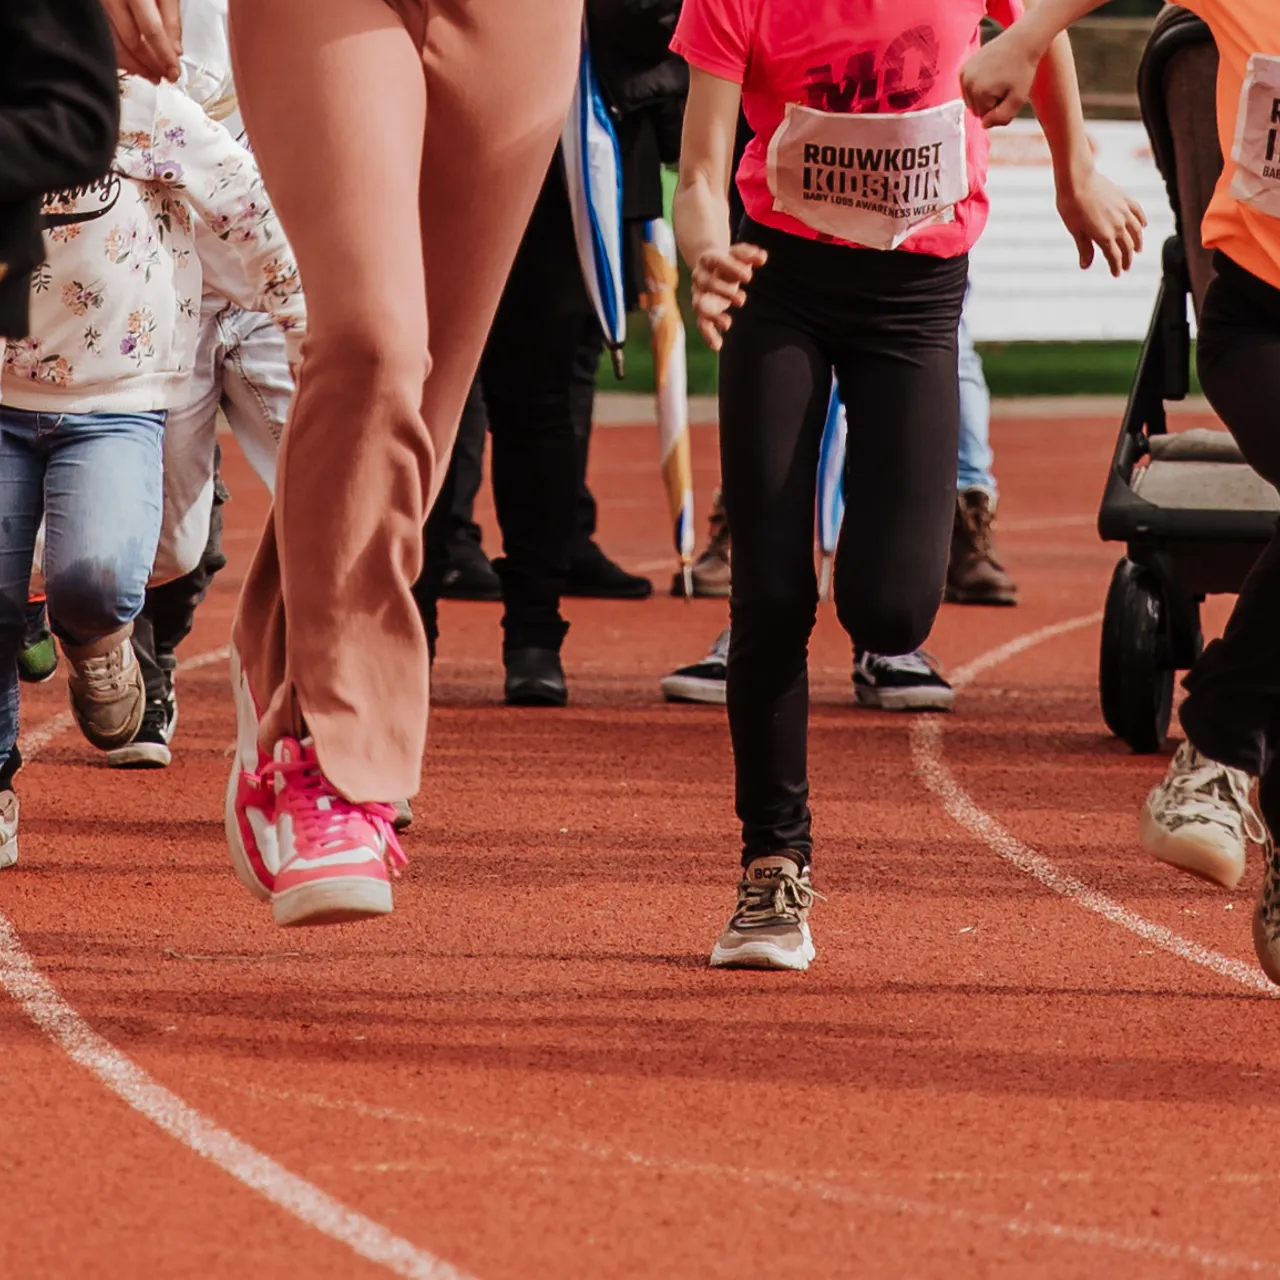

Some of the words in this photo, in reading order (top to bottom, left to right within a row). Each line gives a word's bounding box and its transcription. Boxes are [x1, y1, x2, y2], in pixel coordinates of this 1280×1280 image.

[804, 141, 943, 172] ROUWKOST
[803, 167, 941, 204] KIDSRUN
[803, 192, 828, 204] BABY
[830, 195, 854, 207] LOSS
[855, 200, 911, 220] AWARENESS
